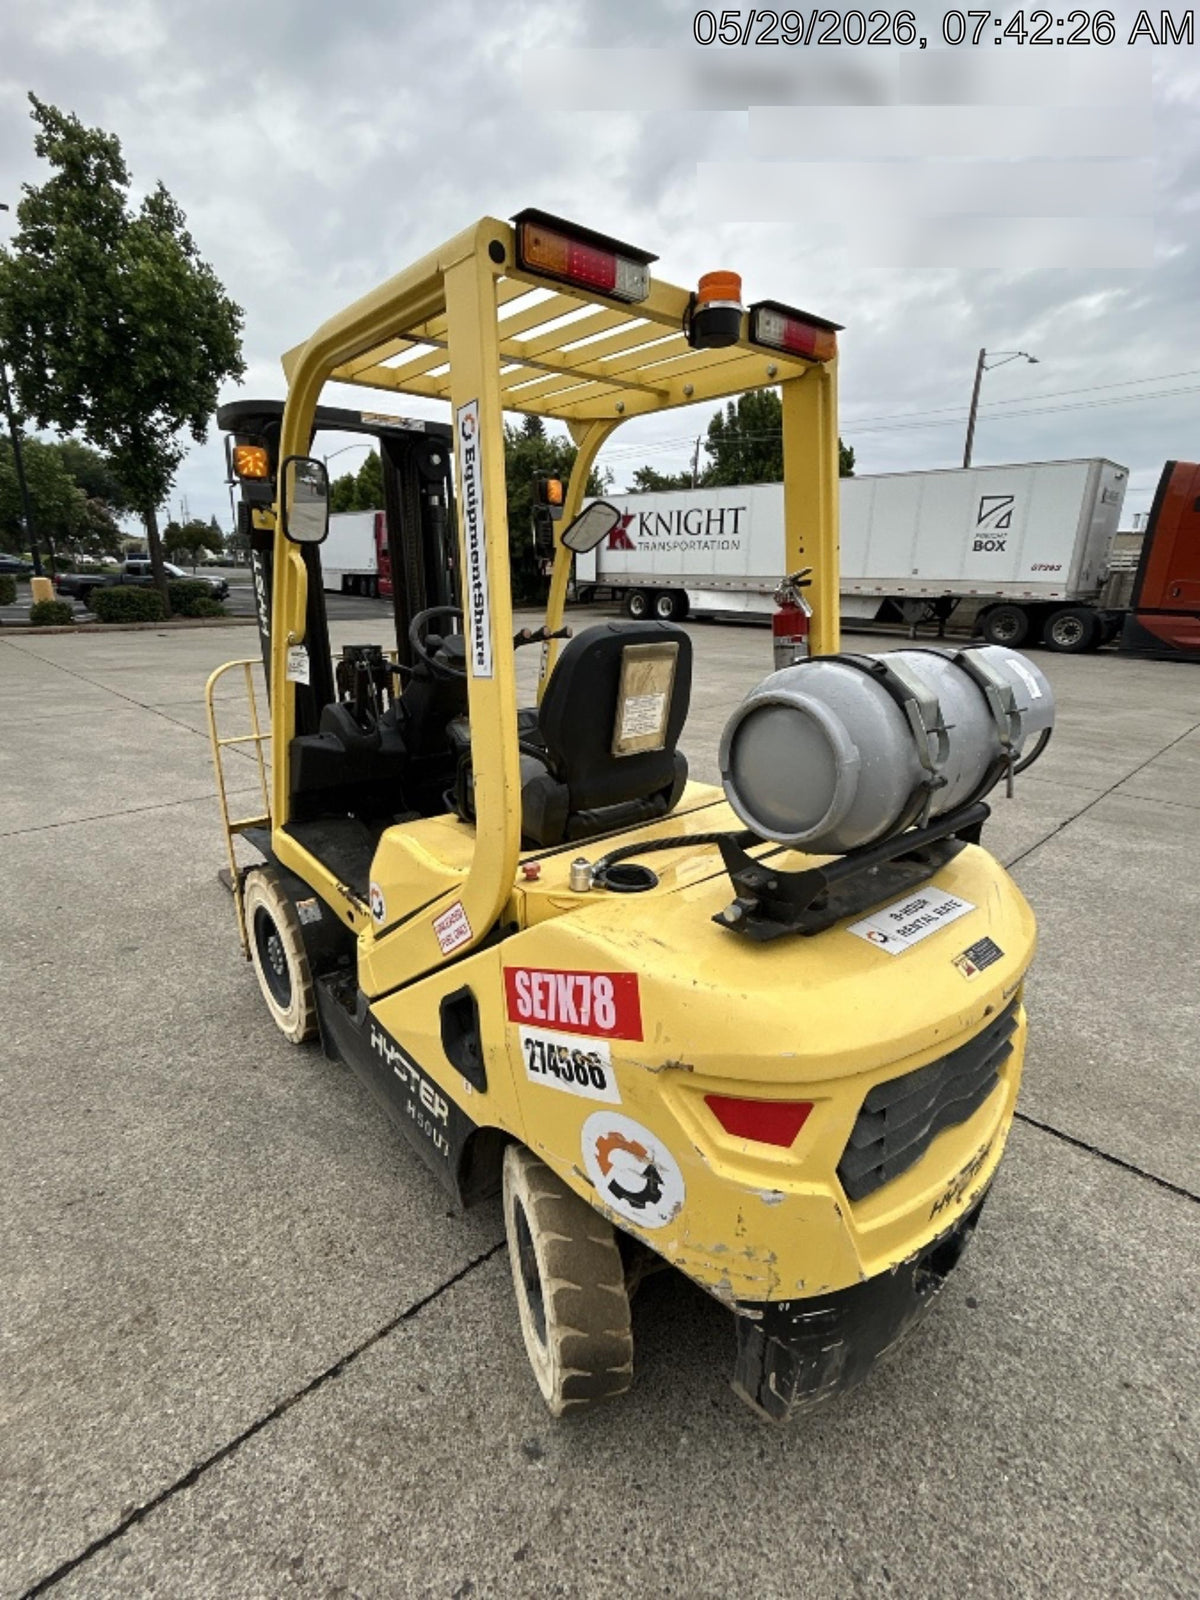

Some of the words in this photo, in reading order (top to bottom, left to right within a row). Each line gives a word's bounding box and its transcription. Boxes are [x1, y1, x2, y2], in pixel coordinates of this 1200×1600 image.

[638, 506, 747, 538] KNIGHT
[462, 444, 486, 667] EquipmentShare
[638, 540, 741, 552] TRANSPORTATION
[972, 540, 1007, 552] BOX
[896, 914, 940, 938] RENTAL
[932, 899, 963, 917] RATE
[514, 970, 617, 1031] SE7K78
[371, 1024, 449, 1127] HYSTER
